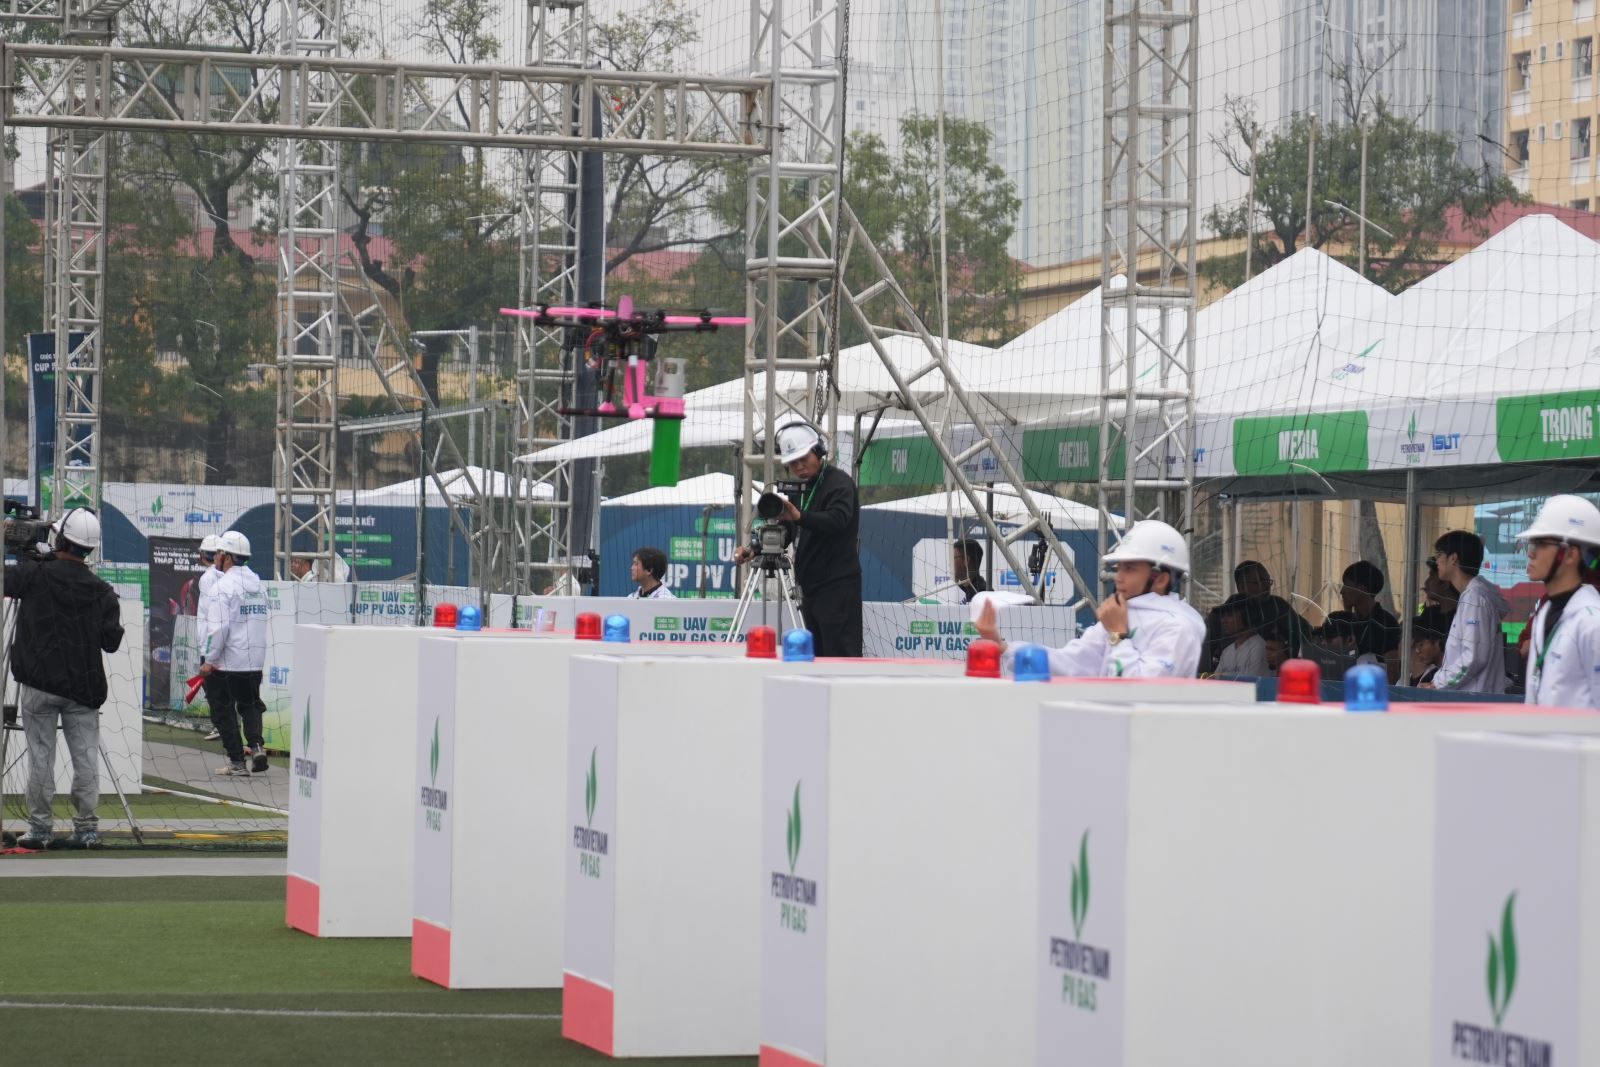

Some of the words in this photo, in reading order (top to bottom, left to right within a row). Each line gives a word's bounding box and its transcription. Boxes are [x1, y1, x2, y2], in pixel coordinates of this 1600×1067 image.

[34, 362, 50, 372] CUP
[1540, 405, 1593, 449] TRỌNG
[1058, 440, 1090, 468] MEDIA
[1279, 429, 1319, 461] MEDIA
[335, 516, 360, 526] CHUNG
[664, 563, 689, 588] UP
[372, 603, 385, 615] PV
[387, 604, 406, 616] GAS
[382, 591, 400, 603] UAV
[240, 604, 268, 616] REFEREE
[683, 616, 708, 631] UAV
[938, 621, 962, 635] UAV
[639, 632, 665, 642] CUP
[670, 632, 687, 643] PV
[690, 632, 716, 643] GAS
[895, 636, 922, 651] CUP
[925, 637, 942, 651] PV
[945, 637, 971, 651] GAS
[573, 824, 608, 855] PETROVIETNAM
[580, 851, 588, 877] PV
[588, 853, 601, 879] GAS
[771, 871, 817, 906] PETROVIETNAM
[780, 902, 791, 929] PV
[791, 904, 808, 934] GAS
[1050, 935, 1111, 981] PETROVIETNAM
[1062, 973, 1075, 1006] PV
[1077, 977, 1098, 1012] GAS
